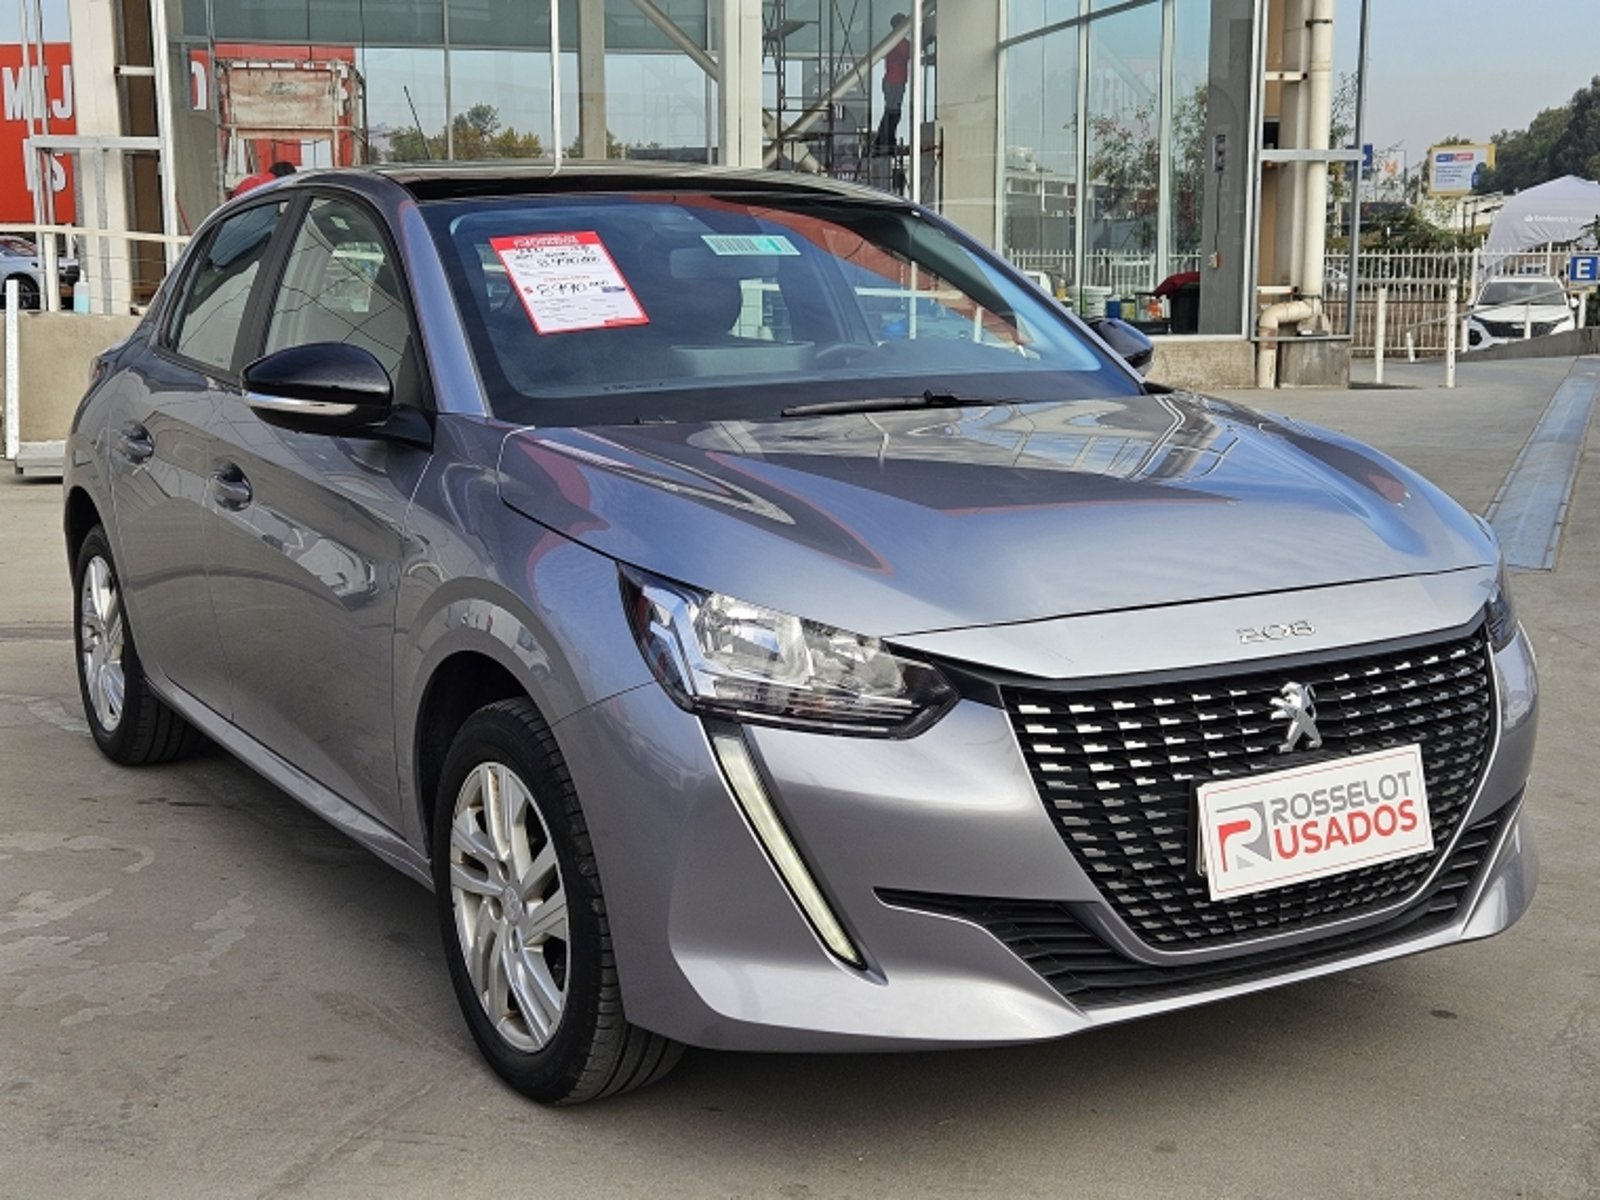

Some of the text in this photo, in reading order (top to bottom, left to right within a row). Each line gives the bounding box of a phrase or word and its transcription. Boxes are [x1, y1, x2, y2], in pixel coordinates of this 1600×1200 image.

[1576, 258, 1592, 279] E
[1236, 620, 1316, 644] 208
[1270, 771, 1411, 826] ROSSELOT
[1274, 799, 1418, 859] USADOS
